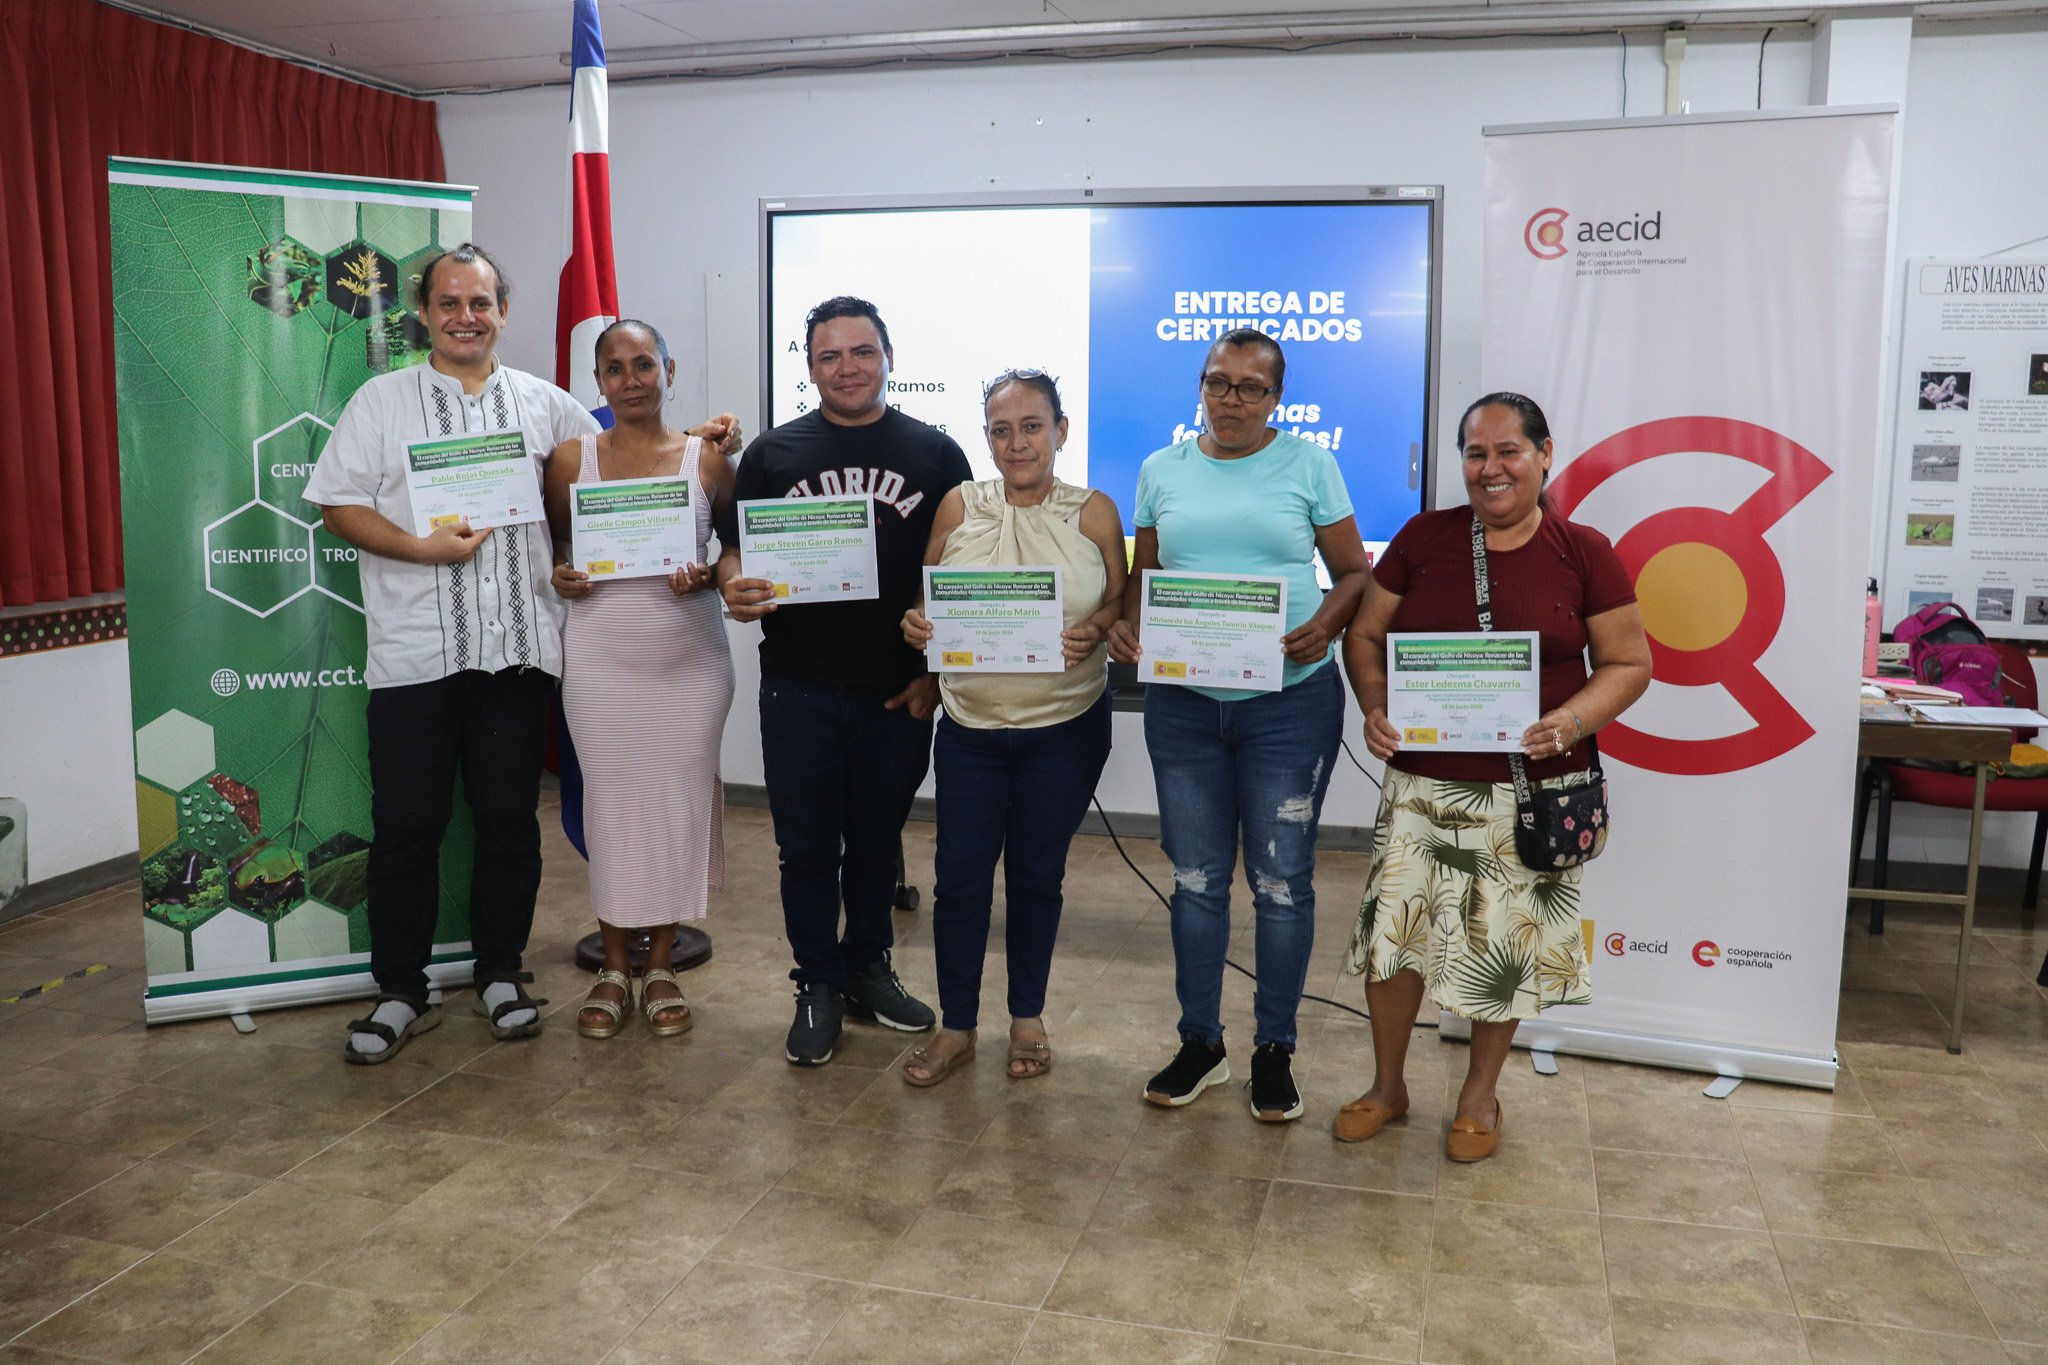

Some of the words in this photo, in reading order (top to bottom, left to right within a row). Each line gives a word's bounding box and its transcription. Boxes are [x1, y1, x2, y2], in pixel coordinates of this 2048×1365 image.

[1576, 210, 1661, 242] aecid
[1577, 250, 1607, 258] Agencia
[1609, 248, 1642, 258] Española
[1576, 259, 1586, 267] de
[1588, 258, 1635, 270] Cooperación
[1637, 256, 1687, 266] Internacional
[1594, 267, 1601, 275] el
[1603, 267, 1641, 275] Desarrollo
[1944, 266, 1979, 293] AVES
[1982, 265, 2046, 293] MARINAS
[1174, 291, 1303, 314] ENTREGA
[1309, 291, 1345, 314] DE
[887, 380, 945, 393] Ramos
[431, 474, 454, 483] Pablo
[455, 470, 478, 482] Rojas
[478, 465, 514, 478] Quesada
[784, 467, 924, 519] FLORIDA
[587, 519, 613, 529] Giselle
[614, 517, 645, 528] Campos
[647, 514, 679, 523] Villareal
[1472, 512, 1486, 558] AG.1980
[752, 541, 775, 551] Jorge
[777, 539, 806, 548] Steven
[807, 537, 832, 546] Garro
[834, 535, 862, 544] Ramos
[211, 548, 308, 564] CIENTIFICO
[1221, 620, 1246, 628] Tenorio
[1405, 679, 1428, 688] Ester
[1431, 679, 1471, 688] Ledezma
[1473, 679, 1520, 688] Chavarría
[1629, 940, 1669, 955] aecid
[1727, 947, 1792, 961] cooperación
[1726, 957, 1774, 969] española
